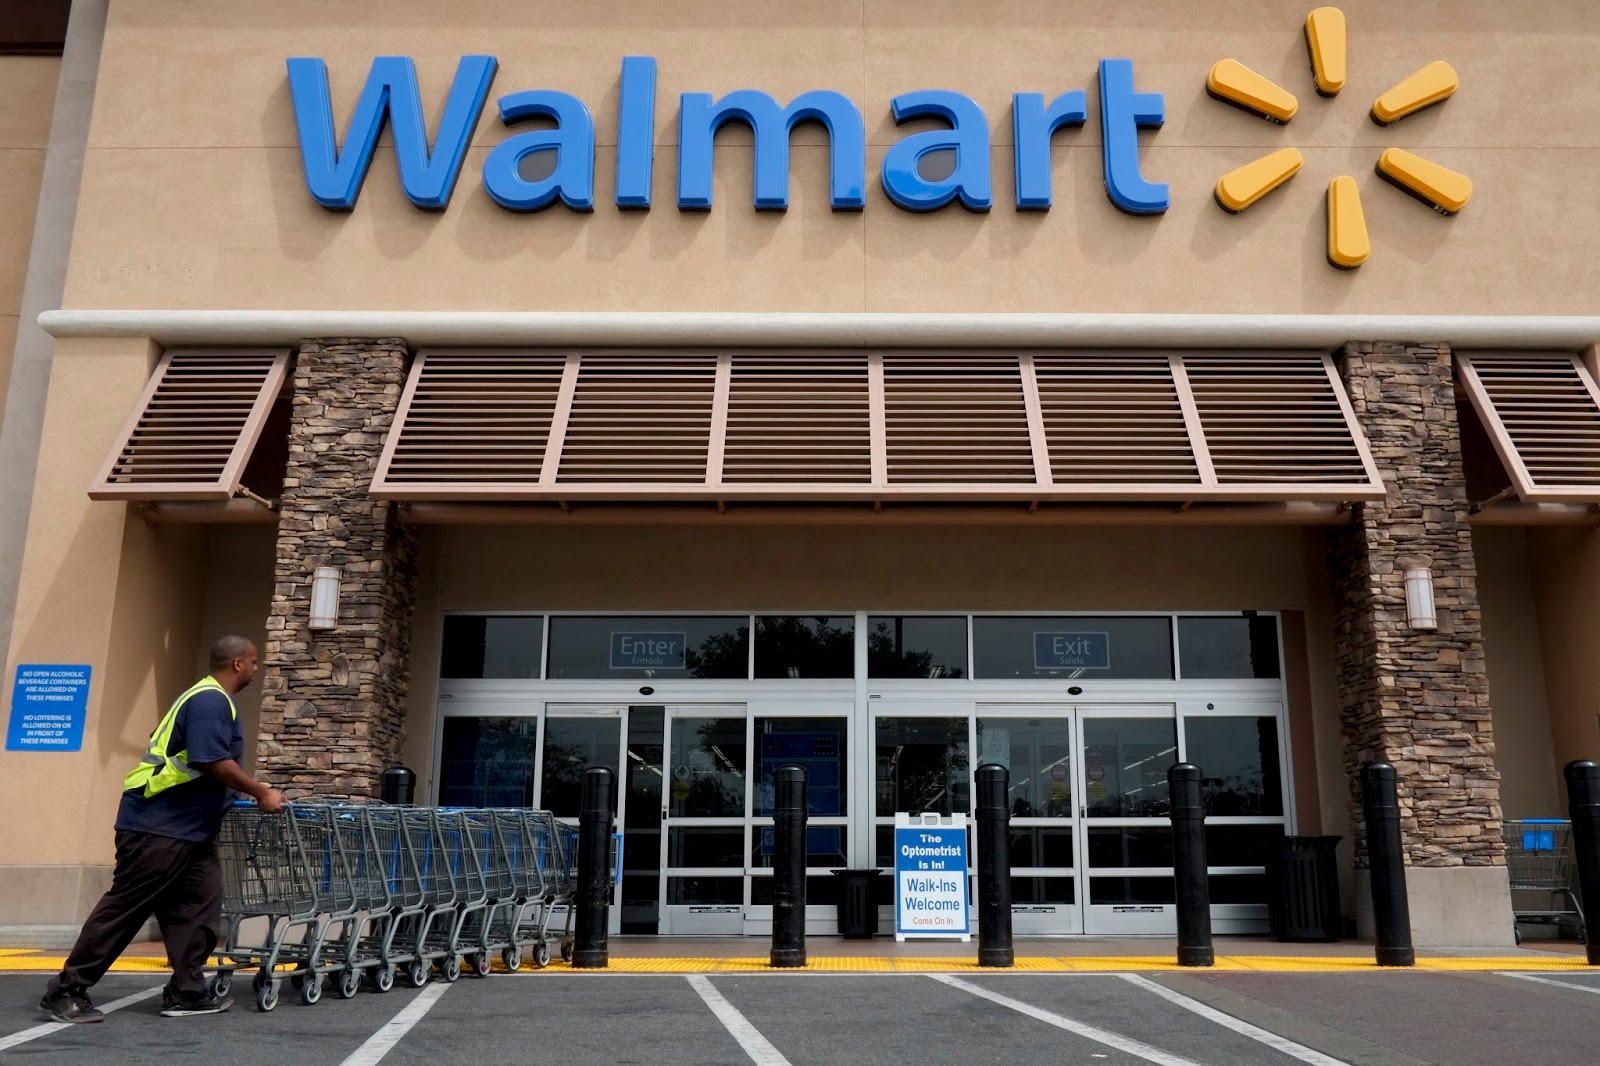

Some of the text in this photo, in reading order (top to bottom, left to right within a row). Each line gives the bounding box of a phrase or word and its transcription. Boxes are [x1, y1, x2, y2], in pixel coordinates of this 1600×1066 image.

[286, 55, 1169, 215] Walmart
[621, 636, 677, 655] Enter
[1053, 636, 1091, 655] Exit
[632, 656, 664, 665] Entrada
[1059, 656, 1084, 665] Salida
[920, 834, 942, 843] The
[902, 845, 962, 859] Optometrist
[919, 861, 945, 869] Is In!
[907, 879, 957, 892] Walk-Ins
[905, 897, 960, 911] Welcome
[913, 917, 933, 925] Come
[935, 917, 945, 925] On
